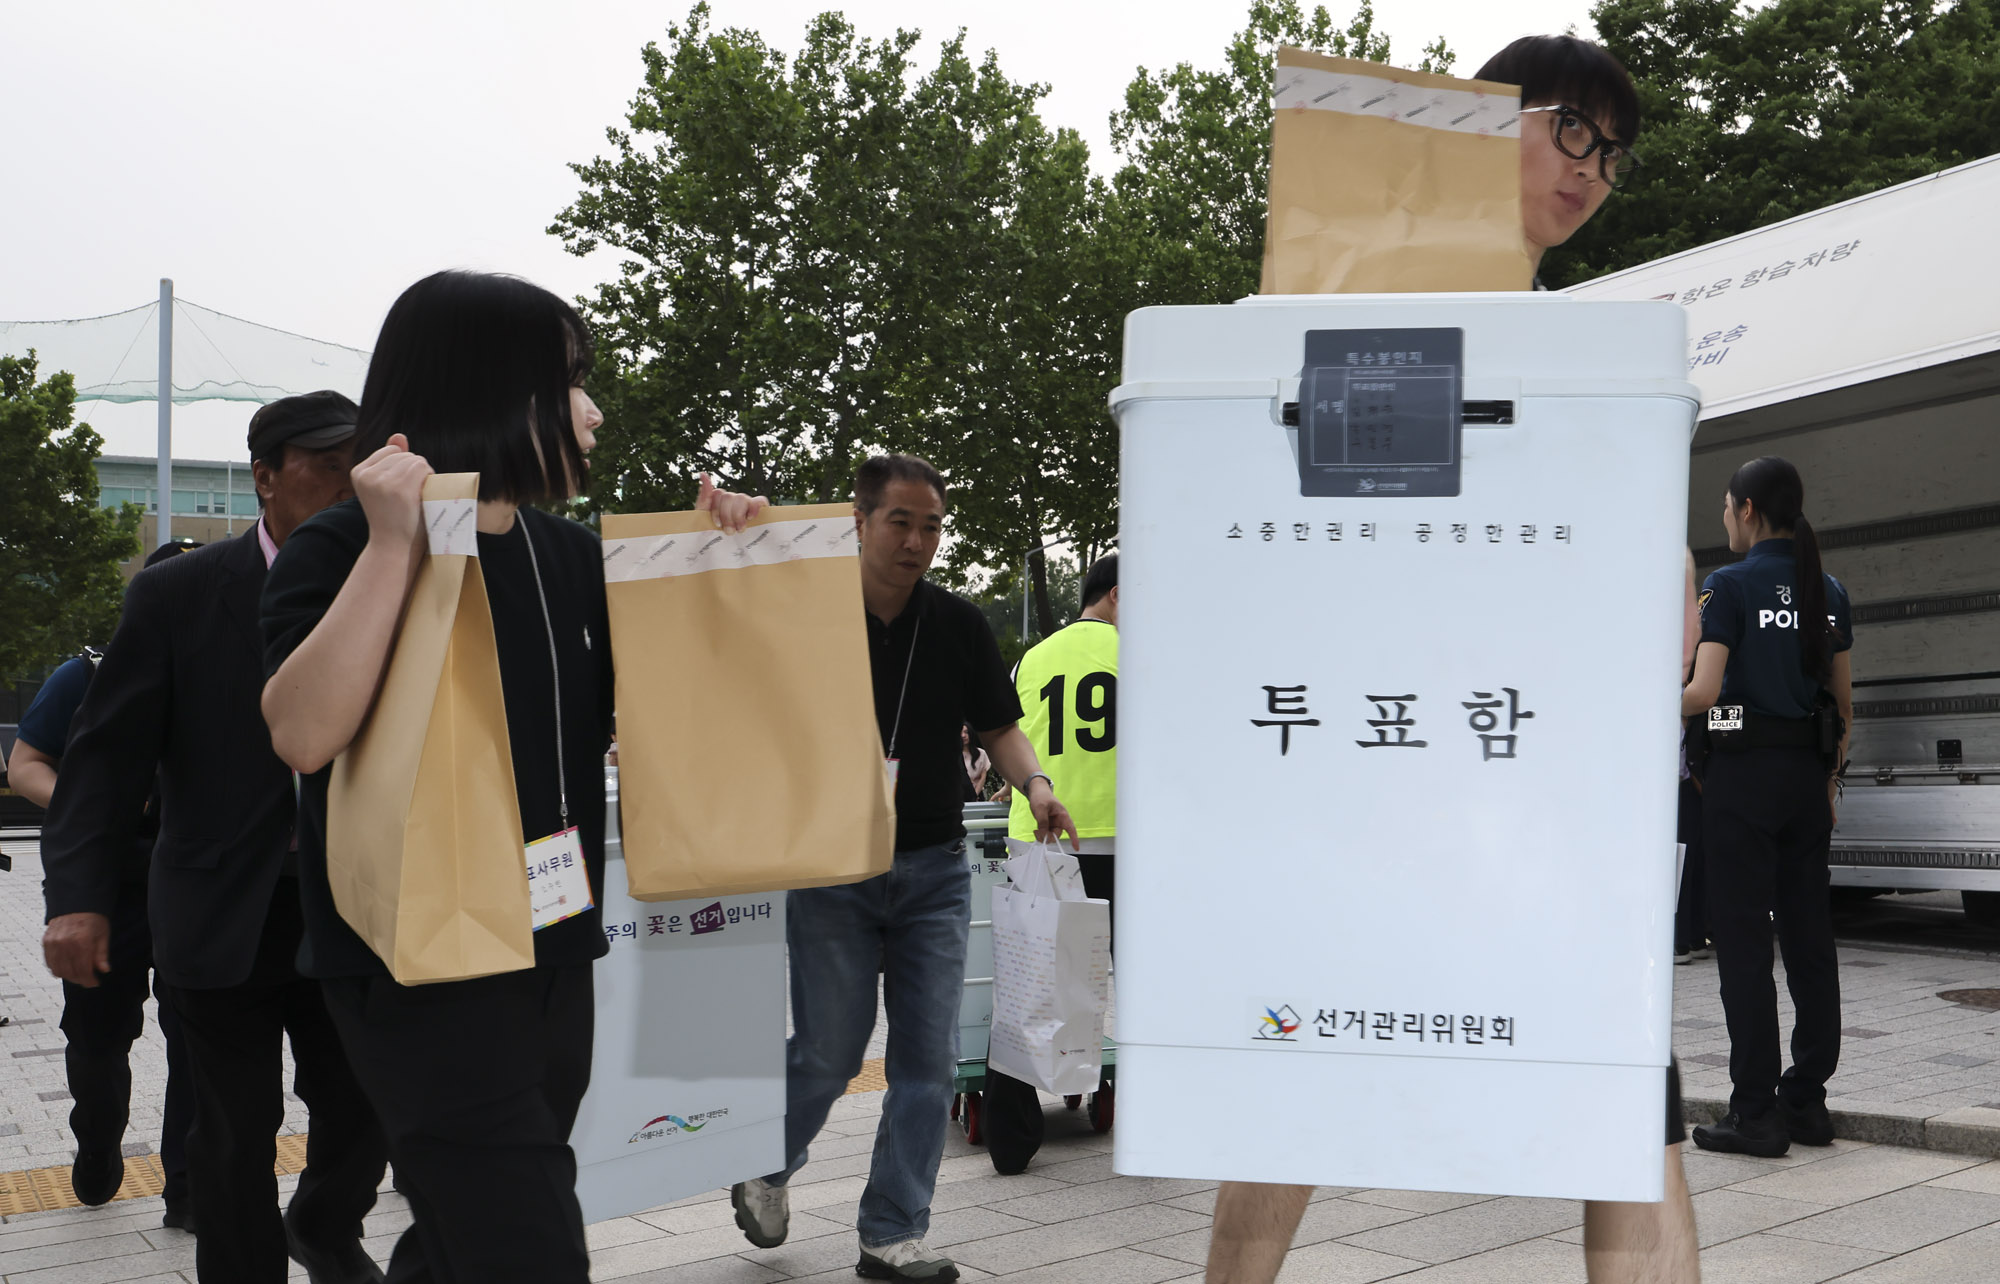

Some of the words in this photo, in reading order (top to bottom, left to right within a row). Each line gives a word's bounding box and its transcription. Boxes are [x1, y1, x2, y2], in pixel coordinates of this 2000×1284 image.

[1680, 278, 1731, 305] 항온
[1738, 239, 1862, 290] 항습차량
[1345, 351, 1423, 365] 특수봉인지
[1226, 521, 1377, 542] 소중한권리
[1413, 522, 1572, 544] 공정한관리
[1775, 584, 1792, 605] 경
[1040, 671, 1117, 757] 19
[1250, 684, 1536, 762] 투표함
[647, 914, 683, 936] 꽃은
[1312, 1008, 1515, 1046] 선거관리위원회
[706, 1107, 729, 1119] 대한민국
[640, 1128, 665, 1140] 아름다운
[666, 1126, 678, 1136] 선거
